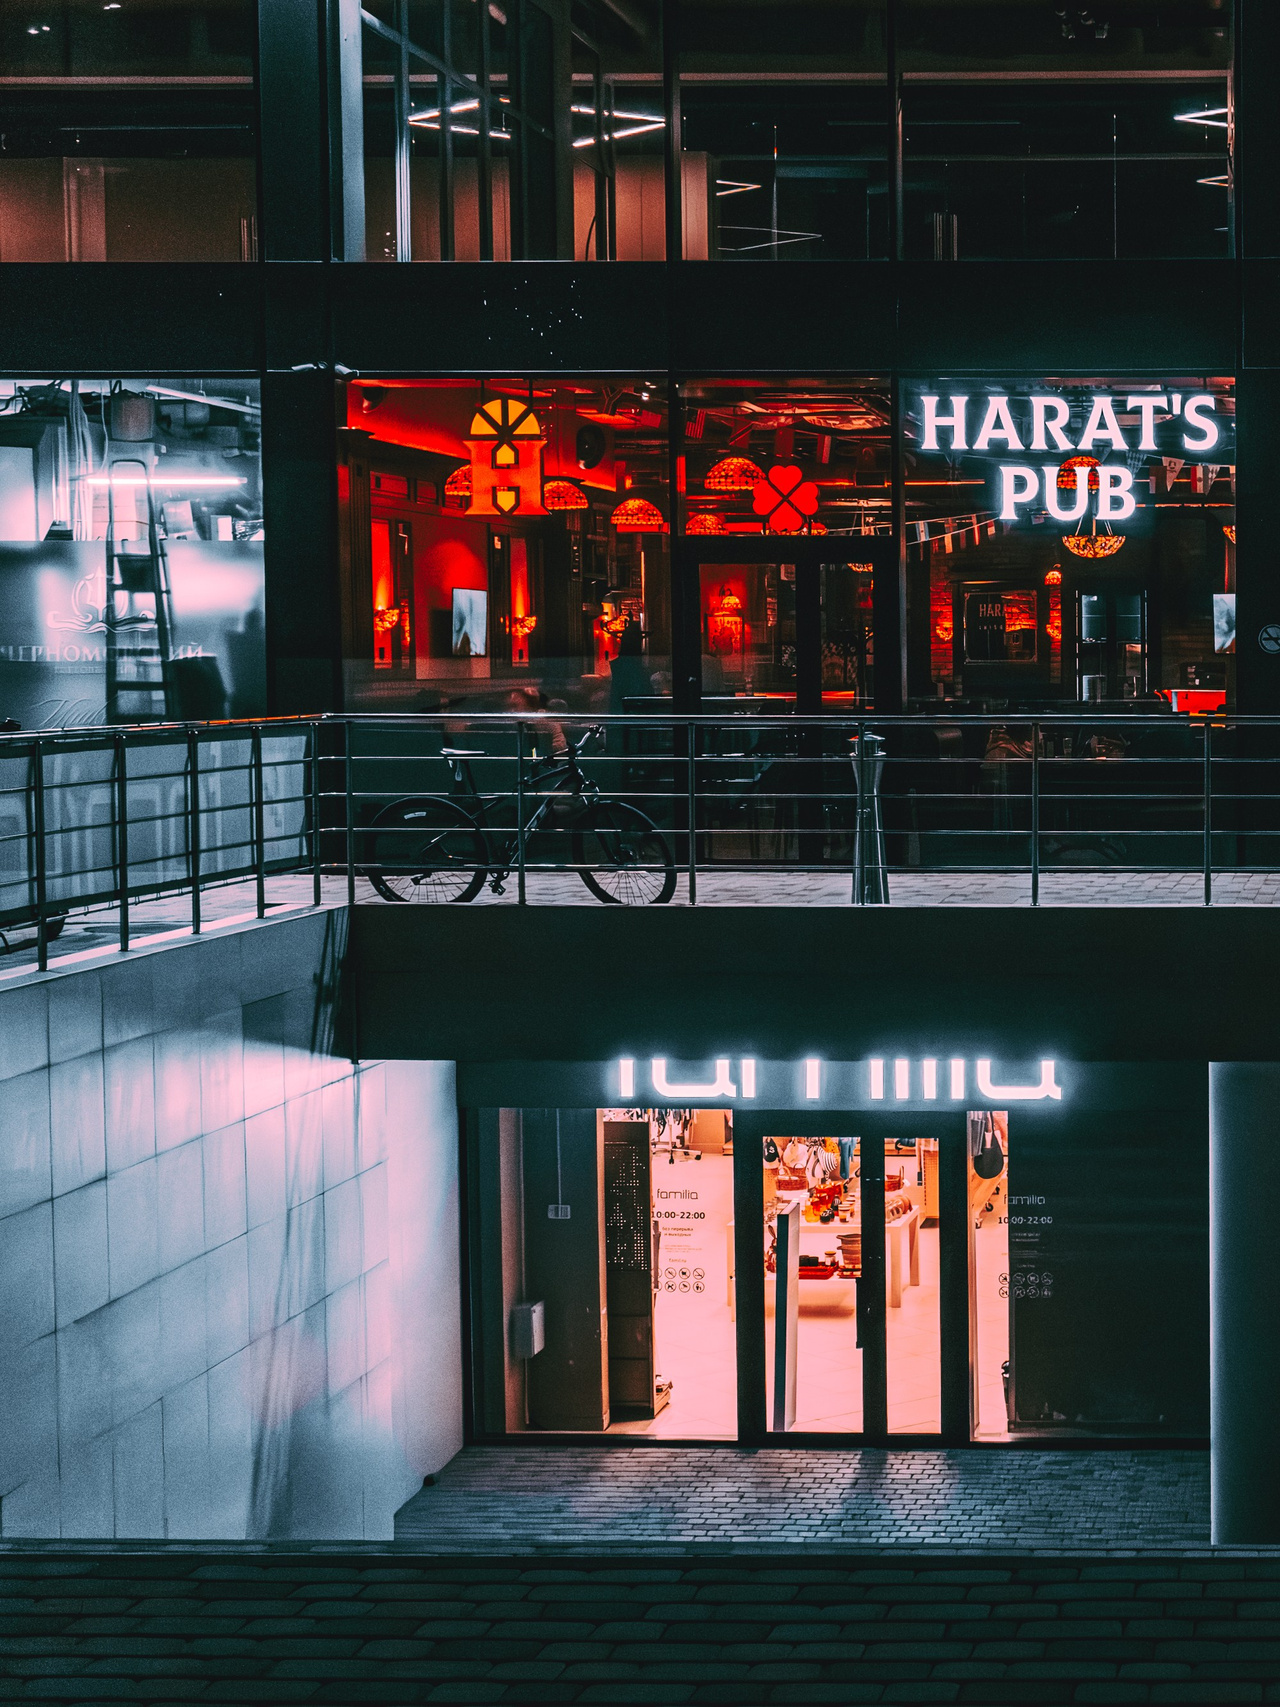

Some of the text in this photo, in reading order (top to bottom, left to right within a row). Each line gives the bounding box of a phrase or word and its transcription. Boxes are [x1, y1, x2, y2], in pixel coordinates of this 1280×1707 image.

[920, 394, 1219, 450] HARAT'S
[999, 465, 1137, 521] PUB
[657, 1188, 699, 1200] familia
[1003, 1194, 1046, 1205] familia
[651, 1211, 706, 1220] 10:00-22:00
